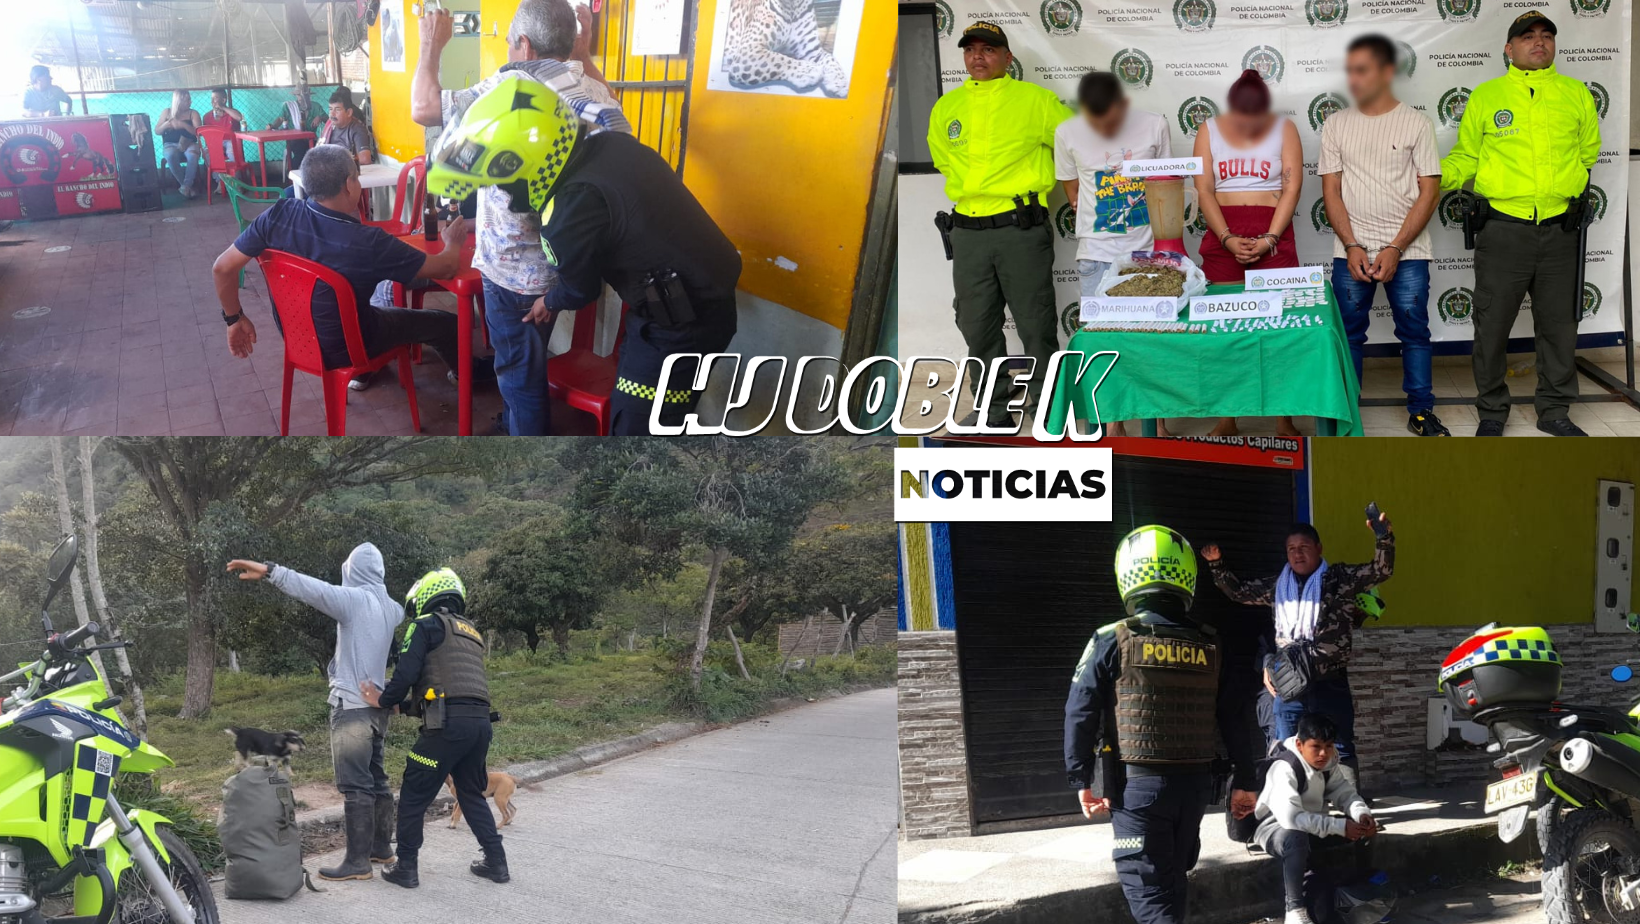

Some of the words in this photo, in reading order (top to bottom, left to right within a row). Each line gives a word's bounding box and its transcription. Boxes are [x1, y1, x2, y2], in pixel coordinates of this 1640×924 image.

[1361, 0, 1389, 8] POLICÍA
[967, 11, 993, 19] POLICÍA
[1457, 52, 1492, 60] NACIONAL
[1296, 58, 1324, 66] POLICÍA
[1035, 65, 1062, 73] POLICÍA
[1141, 164, 1186, 173] LICUADORA
[1218, 158, 1272, 181] BULLS
[1095, 186, 1115, 200] THE
[1266, 276, 1308, 286] COCAINA
[1101, 305, 1155, 313] MARIHUANA
[1208, 301, 1257, 313] BAZUCO
[1247, 436, 1299, 452] Capilares
[1133, 555, 1181, 567] POLICÍA
[1142, 643, 1208, 666] POLICIA
[65, 704, 126, 739] POLICÍA
